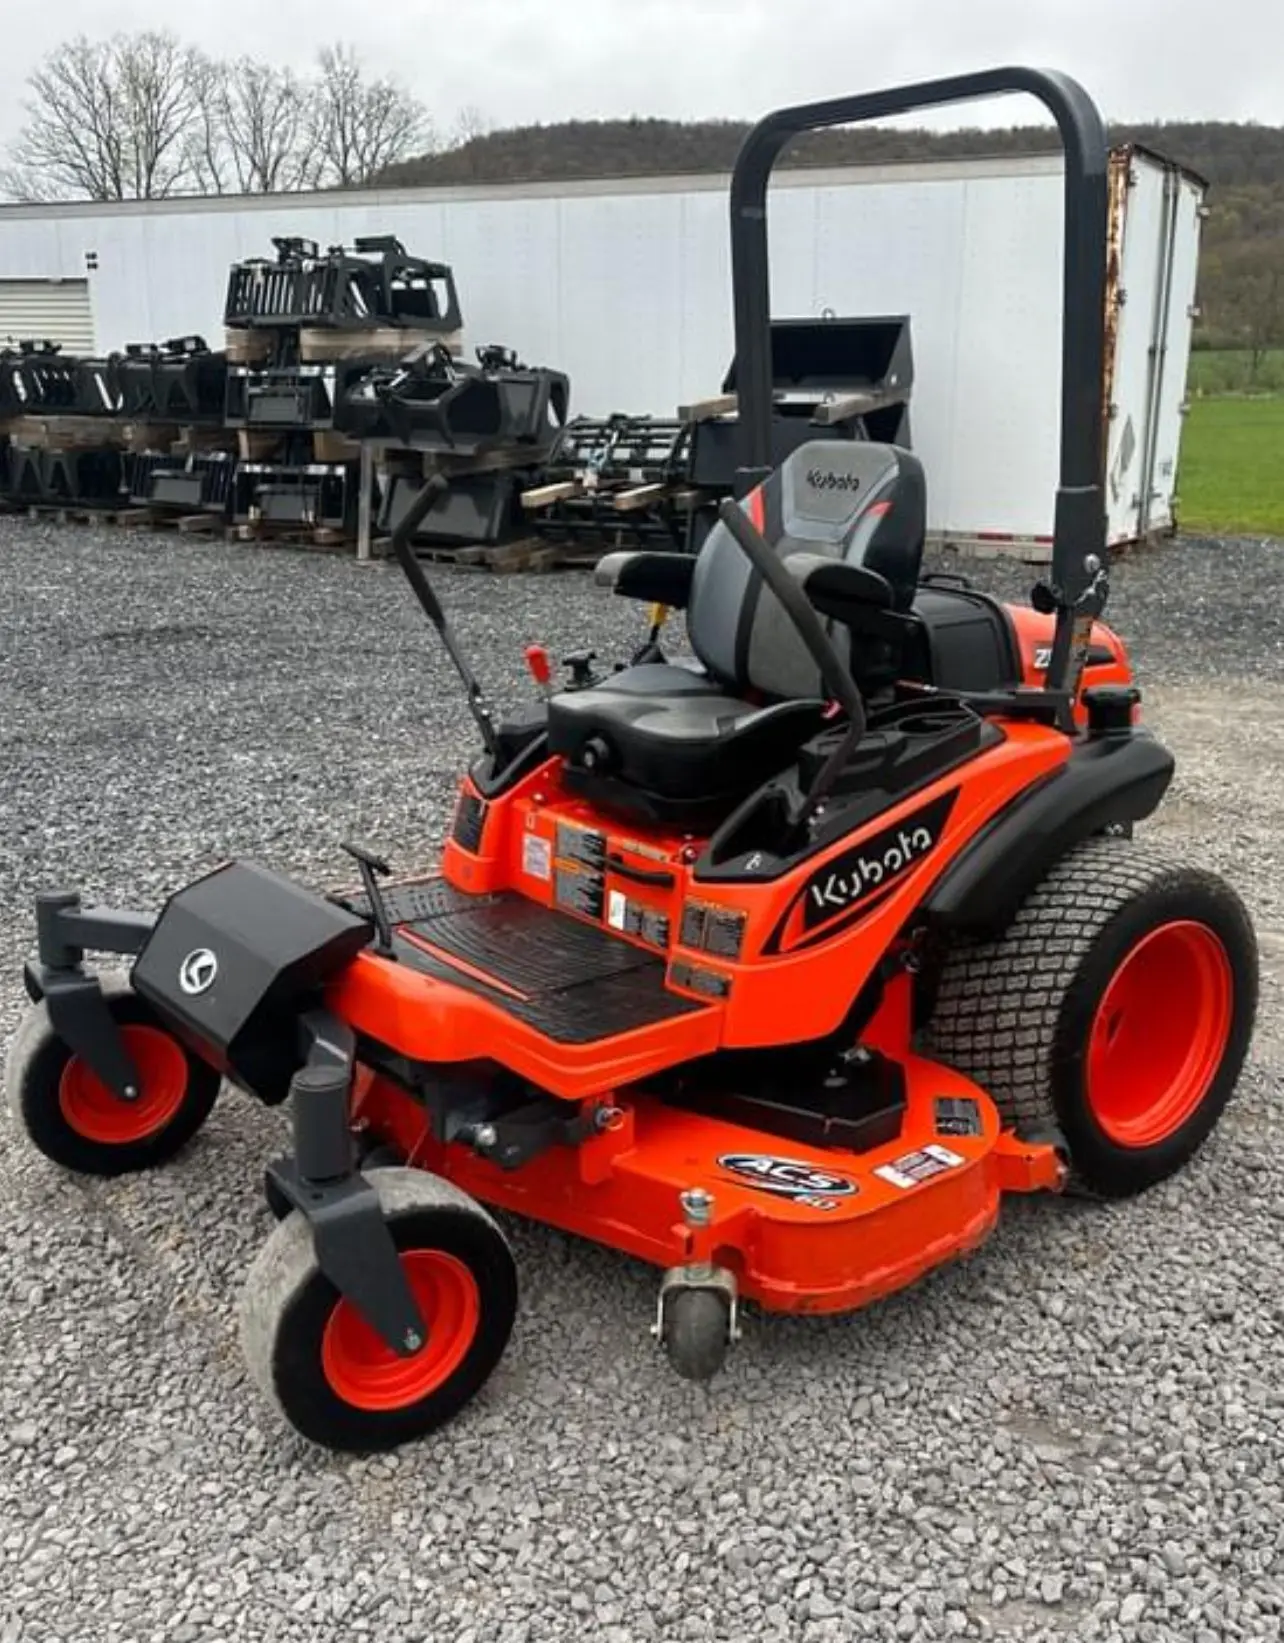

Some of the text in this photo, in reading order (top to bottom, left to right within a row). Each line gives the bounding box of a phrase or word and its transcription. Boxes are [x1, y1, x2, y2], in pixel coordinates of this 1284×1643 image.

[806, 469, 860, 492] Kubota
[811, 827, 932, 908] Kubota
[732, 1157, 842, 1189] ACS
